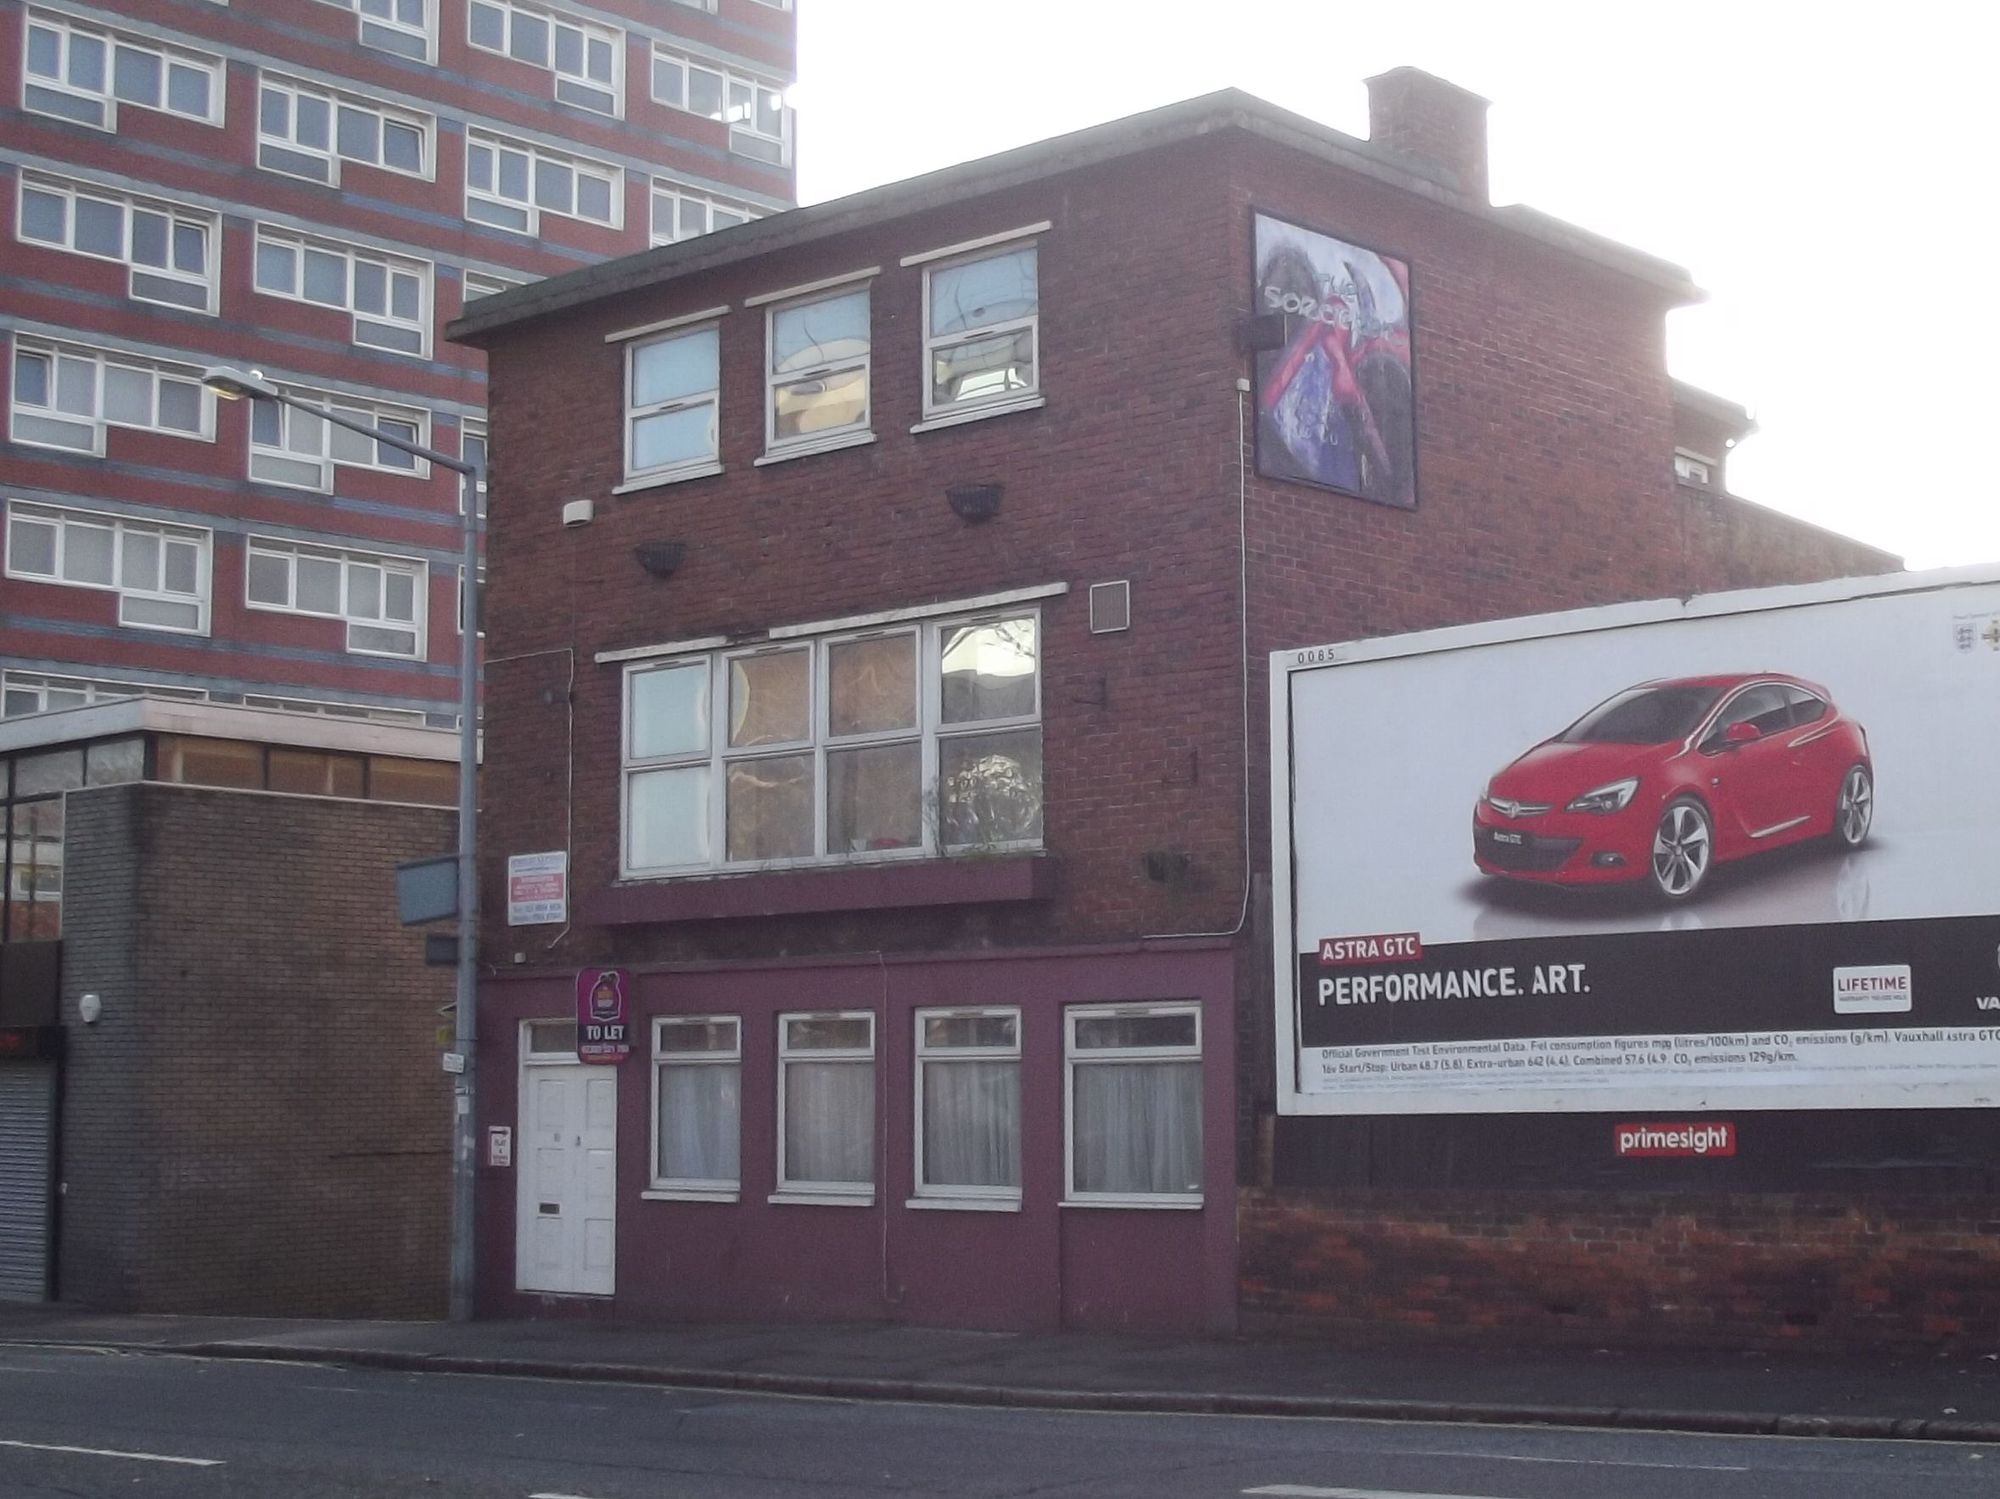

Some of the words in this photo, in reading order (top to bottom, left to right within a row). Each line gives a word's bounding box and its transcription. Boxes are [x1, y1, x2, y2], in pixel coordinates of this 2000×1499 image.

[1297, 648, 1335, 665] 0085
[1322, 939, 1380, 961] ASTRA
[1383, 937, 1417, 957] GTC
[1318, 967, 1525, 1007] PERFORMANCE.
[1531, 963, 1591, 995] ART.
[1837, 976, 1907, 992] LIFETIME
[586, 1025, 602, 1041] TO
[604, 1025, 625, 1041] LET
[1321, 1048, 1353, 1060] Official
[1354, 1047, 1410, 1059] Government
[1432, 1043, 1501, 1056] Environmental
[1549, 1038, 1612, 1052] consumption
[1614, 1037, 1649, 1052] figures
[1651, 1038, 1673, 1051] mpg
[1674, 1034, 1750, 1049] (litres/100km)
[1751, 1034, 1772, 1047] and
[1795, 1033, 1848, 1046] emissions
[1893, 1030, 1944, 1043] Vauxhall
[1390, 1059, 1419, 1072] Urban
[1573, 1052, 1623, 1067] Combined
[1694, 1050, 1746, 1065] emissions
[1748, 1049, 1798, 1065] 129g/km.
[1620, 1126, 1728, 1154] primesight
